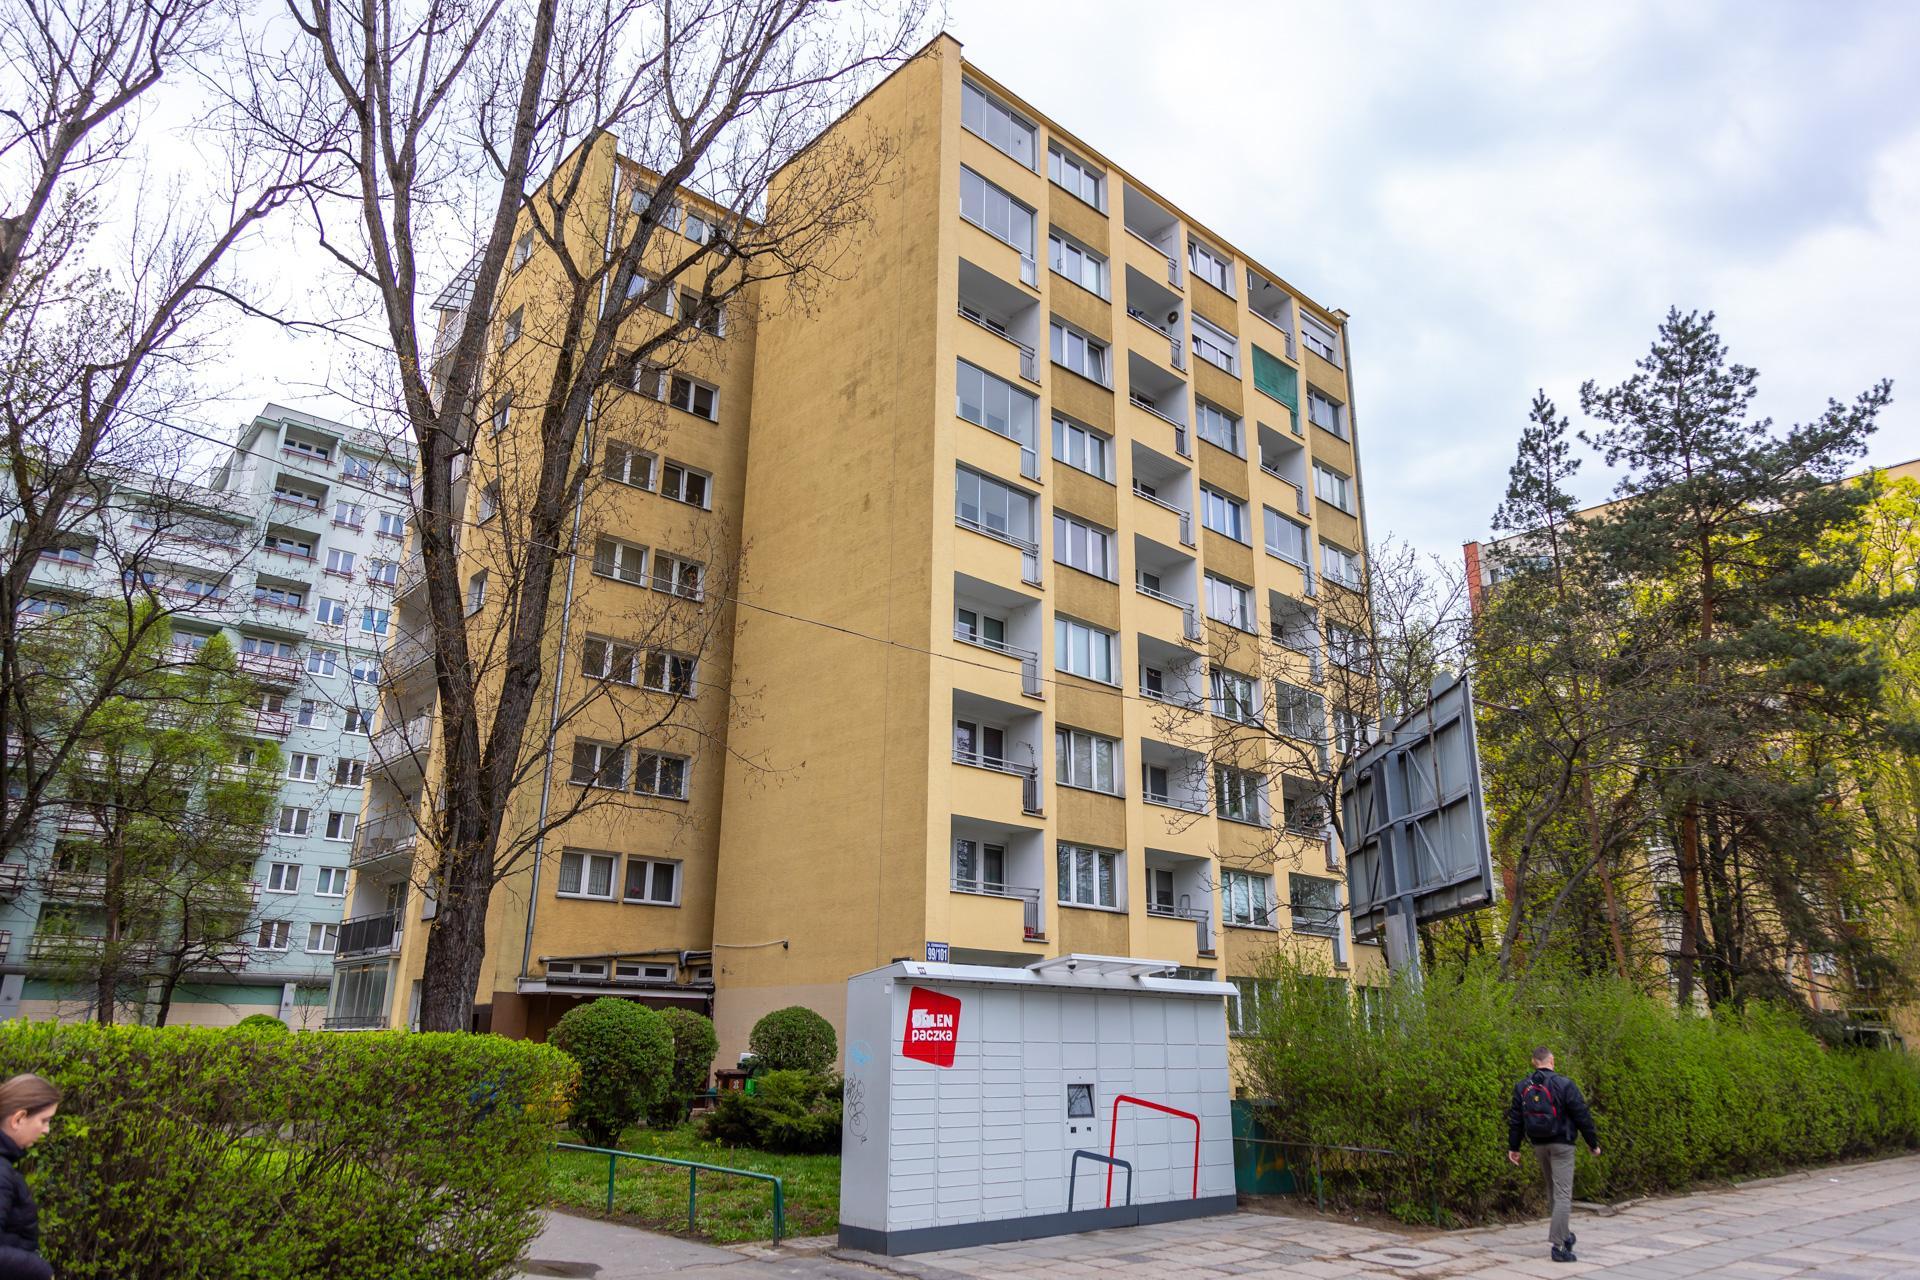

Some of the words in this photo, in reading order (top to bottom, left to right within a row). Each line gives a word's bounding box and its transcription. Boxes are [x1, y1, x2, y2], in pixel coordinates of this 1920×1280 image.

[928, 947, 947, 961] 99/101
[912, 1013, 953, 1028] LEN
[912, 1029, 953, 1043] paczka
